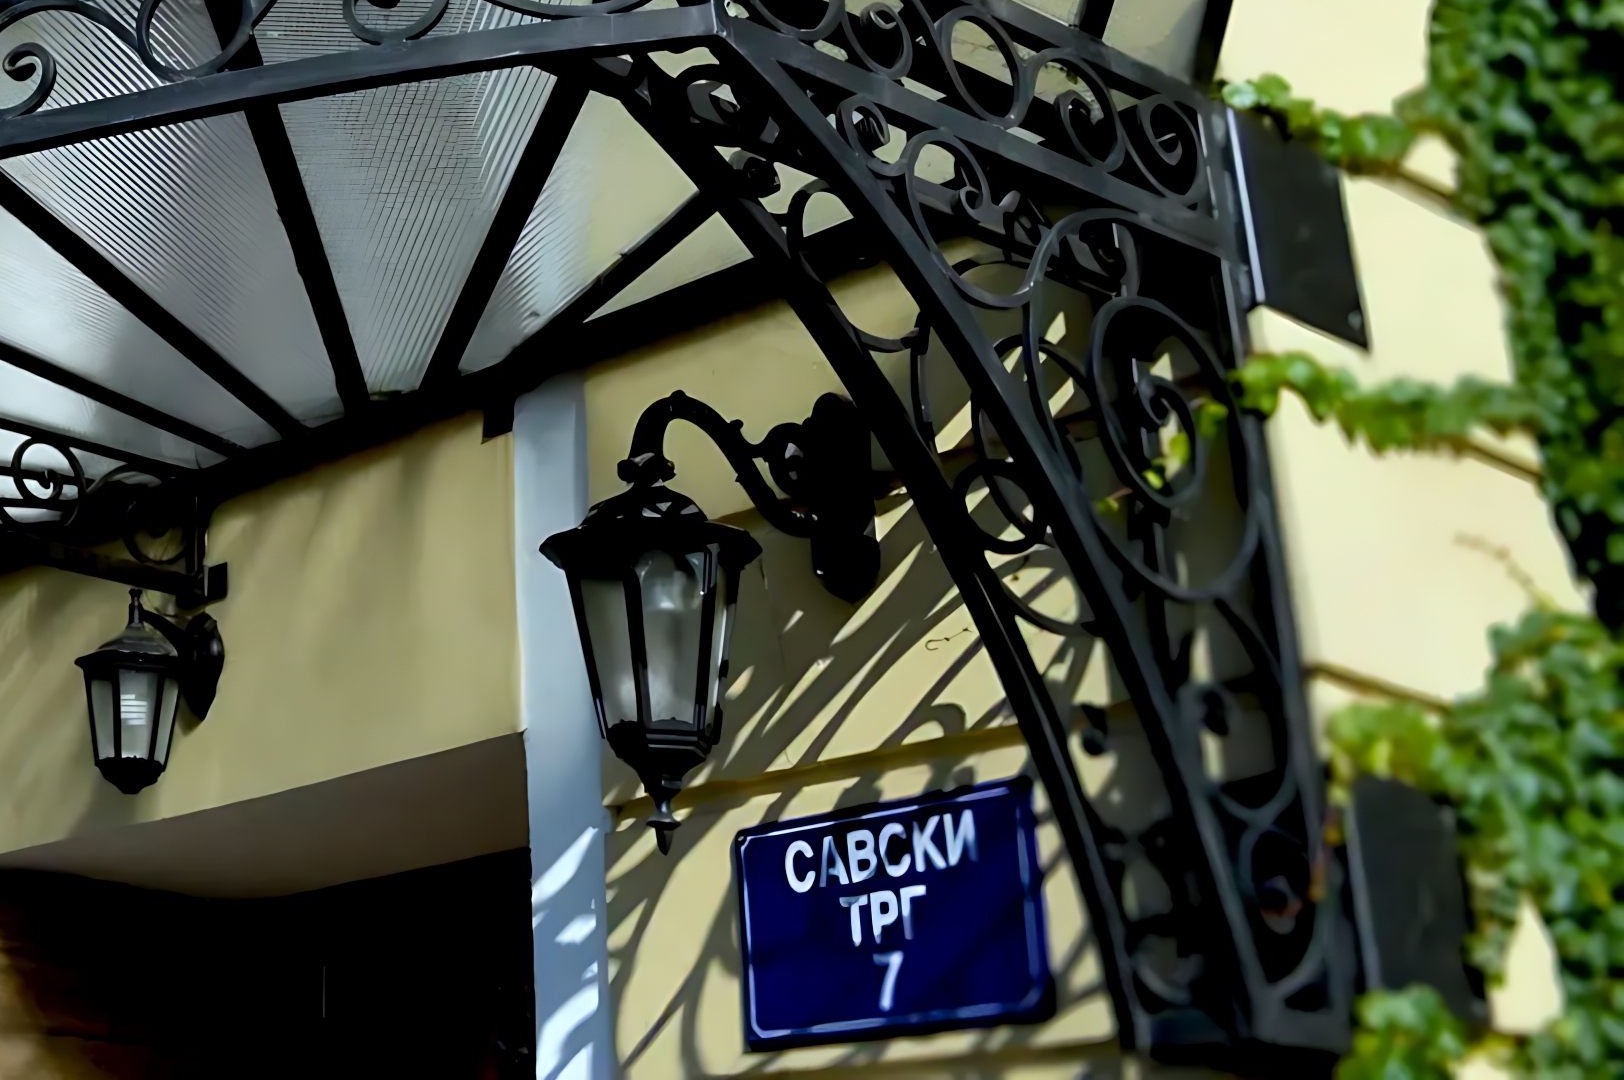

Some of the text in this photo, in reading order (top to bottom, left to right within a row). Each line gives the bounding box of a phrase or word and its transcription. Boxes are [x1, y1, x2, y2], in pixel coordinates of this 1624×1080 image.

[785, 809, 978, 894] САВСКИ
[839, 884, 927, 947] ТРГ
[872, 950, 904, 1012] 7
